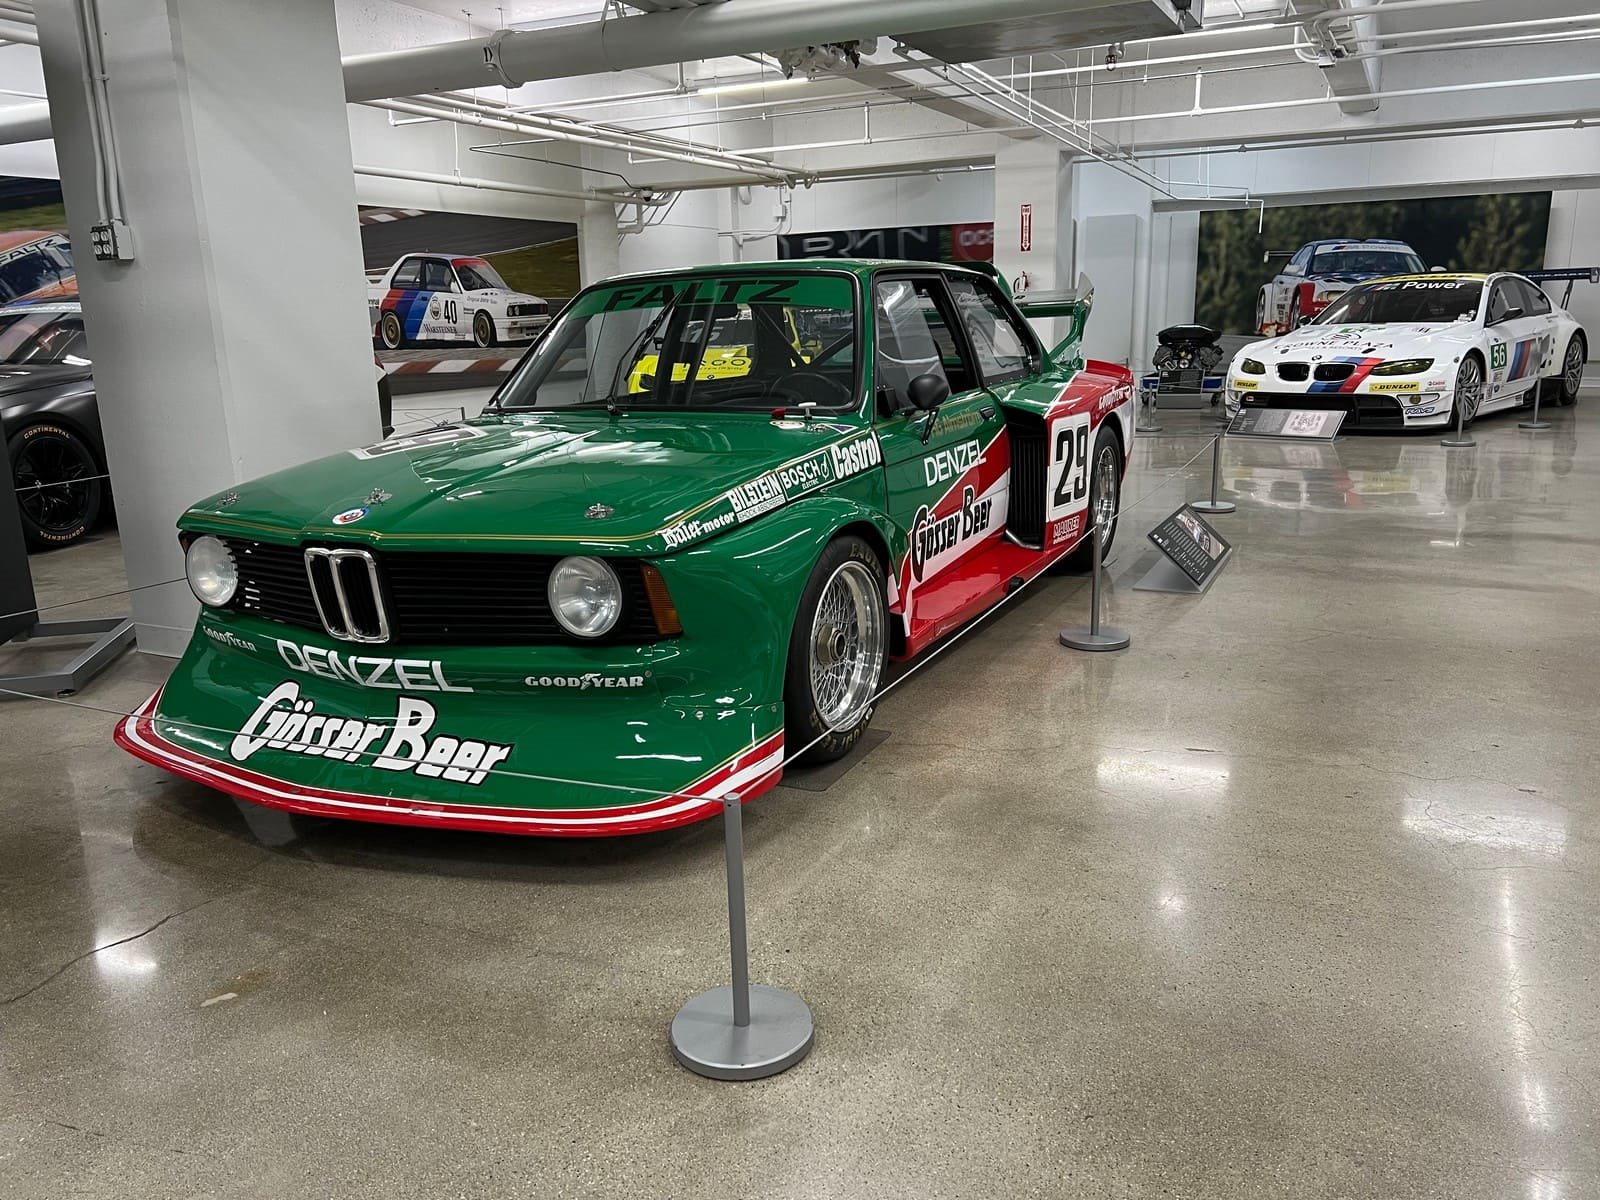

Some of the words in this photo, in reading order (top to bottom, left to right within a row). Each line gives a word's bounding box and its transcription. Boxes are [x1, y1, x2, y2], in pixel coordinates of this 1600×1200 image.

[604, 279, 798, 311] FALTZ
[1402, 281, 1465, 290] Power
[444, 300, 457, 324] 40
[1493, 344, 1506, 366] 56
[23, 426, 70, 439] CONTINENTAL
[831, 432, 882, 480] Castrol
[923, 439, 986, 487] DENZEL
[1054, 425, 1089, 509] 29
[781, 459, 821, 490] BOSCH
[727, 473, 783, 513] BILSTEIN
[202, 625, 258, 653] GOODYEAR
[276, 639, 474, 693] DENZEL
[524, 673, 644, 690] GOODYEAR
[230, 681, 387, 762] Gösser
[371, 696, 514, 785] Beer
